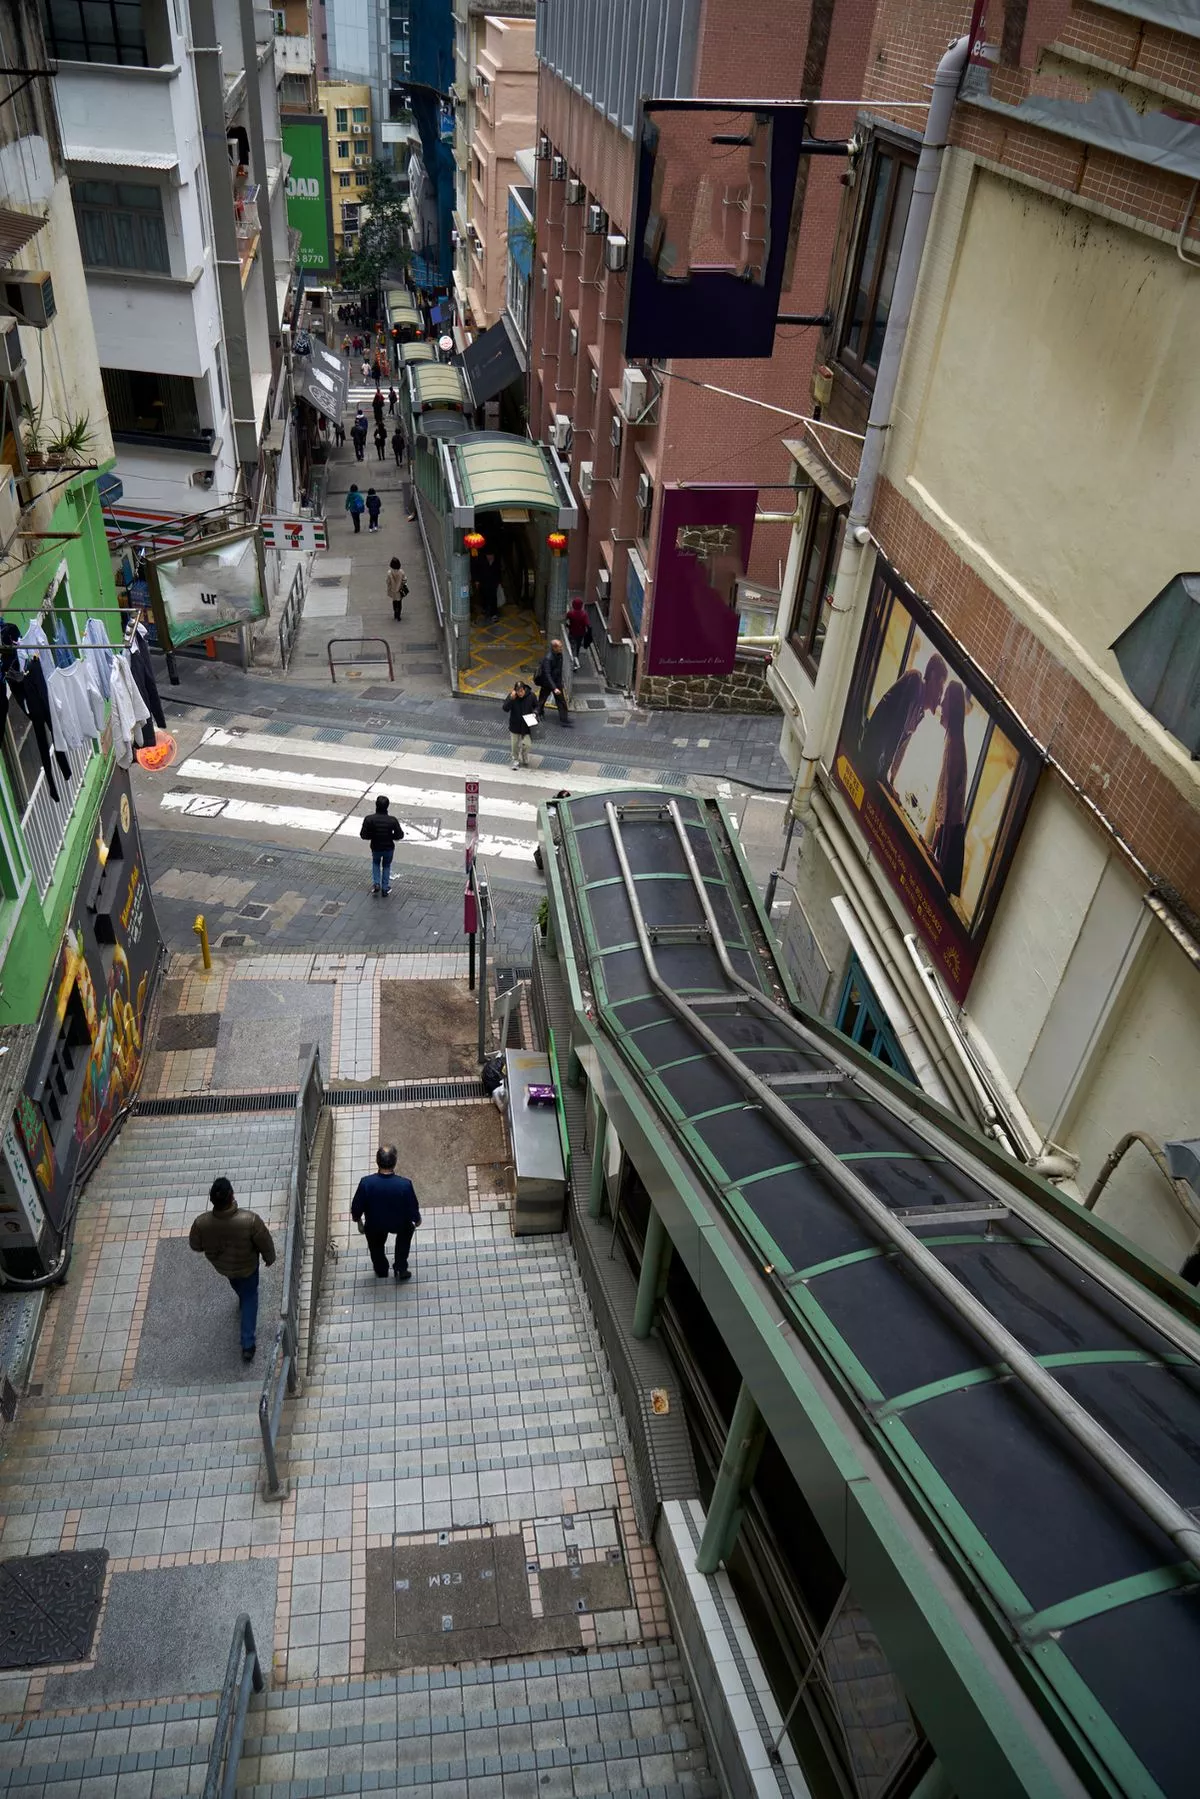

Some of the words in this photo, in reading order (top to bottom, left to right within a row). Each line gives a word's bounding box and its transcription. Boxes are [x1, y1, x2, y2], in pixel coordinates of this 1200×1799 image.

[302, 254, 324, 263] 8770
[284, 523, 303, 548] 7
[201, 592, 217, 605] ur
[428, 1572, 462, 1588] E&M
